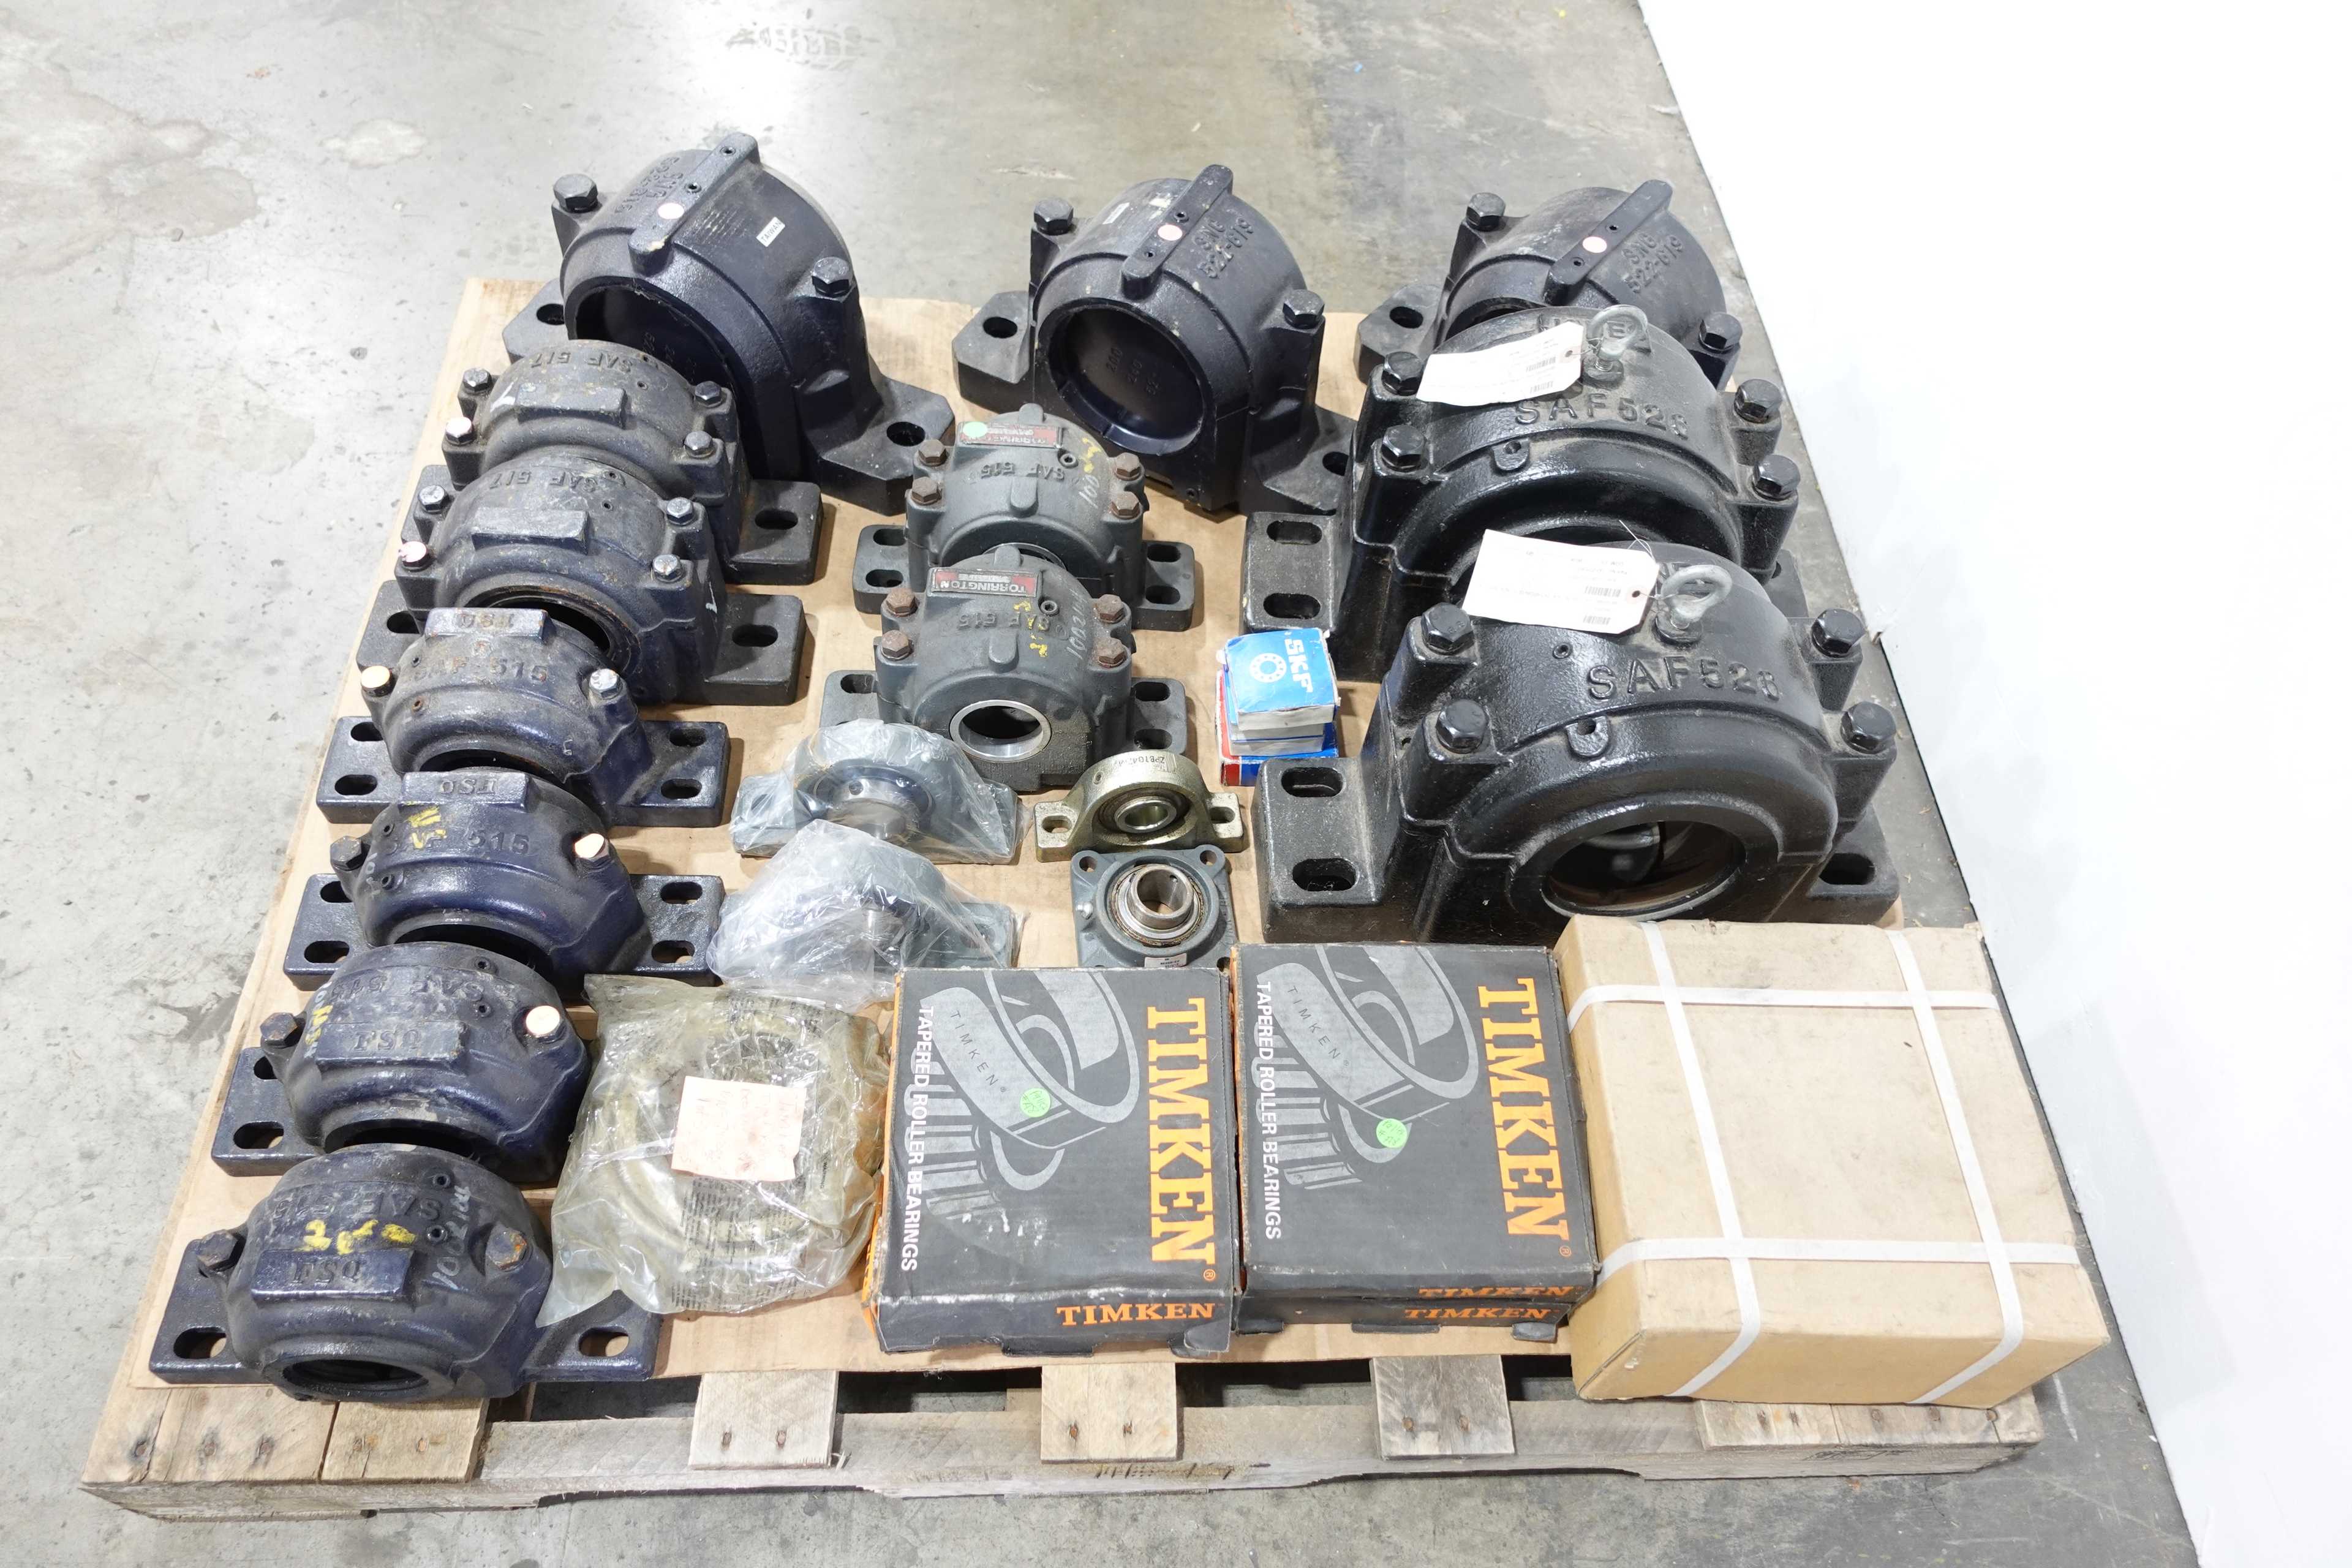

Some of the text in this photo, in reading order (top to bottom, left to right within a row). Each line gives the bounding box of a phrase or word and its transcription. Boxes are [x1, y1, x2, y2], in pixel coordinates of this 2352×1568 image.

[760, 219, 784, 245] TAIWAN
[1622, 233, 1657, 266] SNG
[1624, 234, 1684, 295] 522-619
[980, 462, 1066, 482] SAF 515
[939, 579, 1028, 594] TORRINGTON
[959, 611, 998, 631] 515
[490, 658, 549, 682] 515
[1284, 638, 1314, 693] SKF
[466, 832, 530, 856] 515
[1286, 986, 1341, 1060] TIMKEN
[950, 1009, 998, 1088] TIMKEN
[1256, 981, 1282, 1240] TAPERED ROLLER BEARINGS
[1477, 977, 1570, 1241] TIMKEN
[900, 1005, 935, 1272] TAPERED ROLLER BEARINGS
[1147, 997, 1216, 1265] TIMKEN
[1418, 1286, 1574, 1298] TIMKEN
[1056, 1303, 1216, 1327] TIMKEN
[1404, 1306, 1551, 1319] TIMKEN
